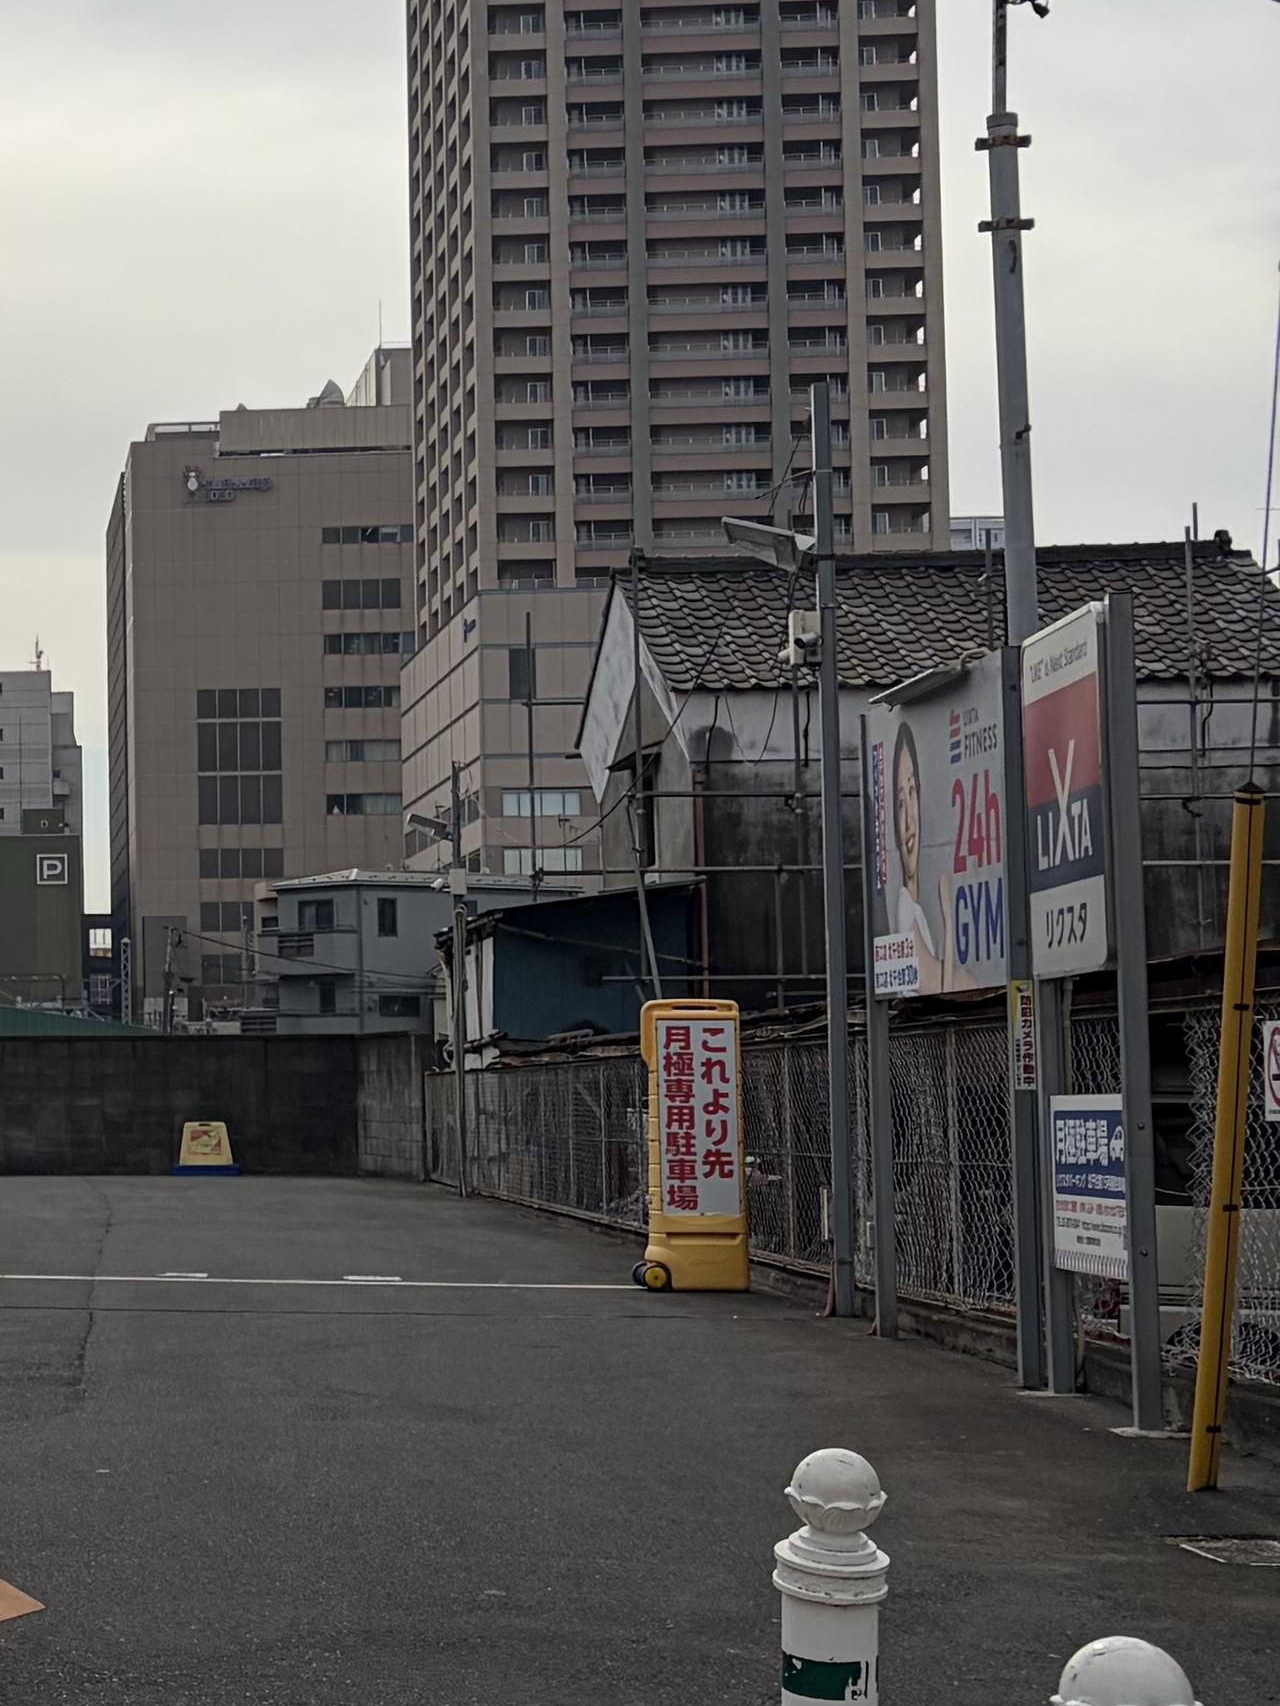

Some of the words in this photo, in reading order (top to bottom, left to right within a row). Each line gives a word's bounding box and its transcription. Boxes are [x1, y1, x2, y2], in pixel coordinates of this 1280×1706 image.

[964, 723, 998, 761] FITNESS
[951, 769, 1002, 875] 24h
[1037, 739, 1093, 871] LIXTA
[43, 860, 62, 879] P
[955, 876, 1005, 966] GYM
[1046, 902, 1087, 950] リクスタ
[663, 1026, 699, 1211] 月極専用駐車場
[701, 1026, 734, 1179] これより先
[1055, 1119, 1109, 1167] 月極駐車場
